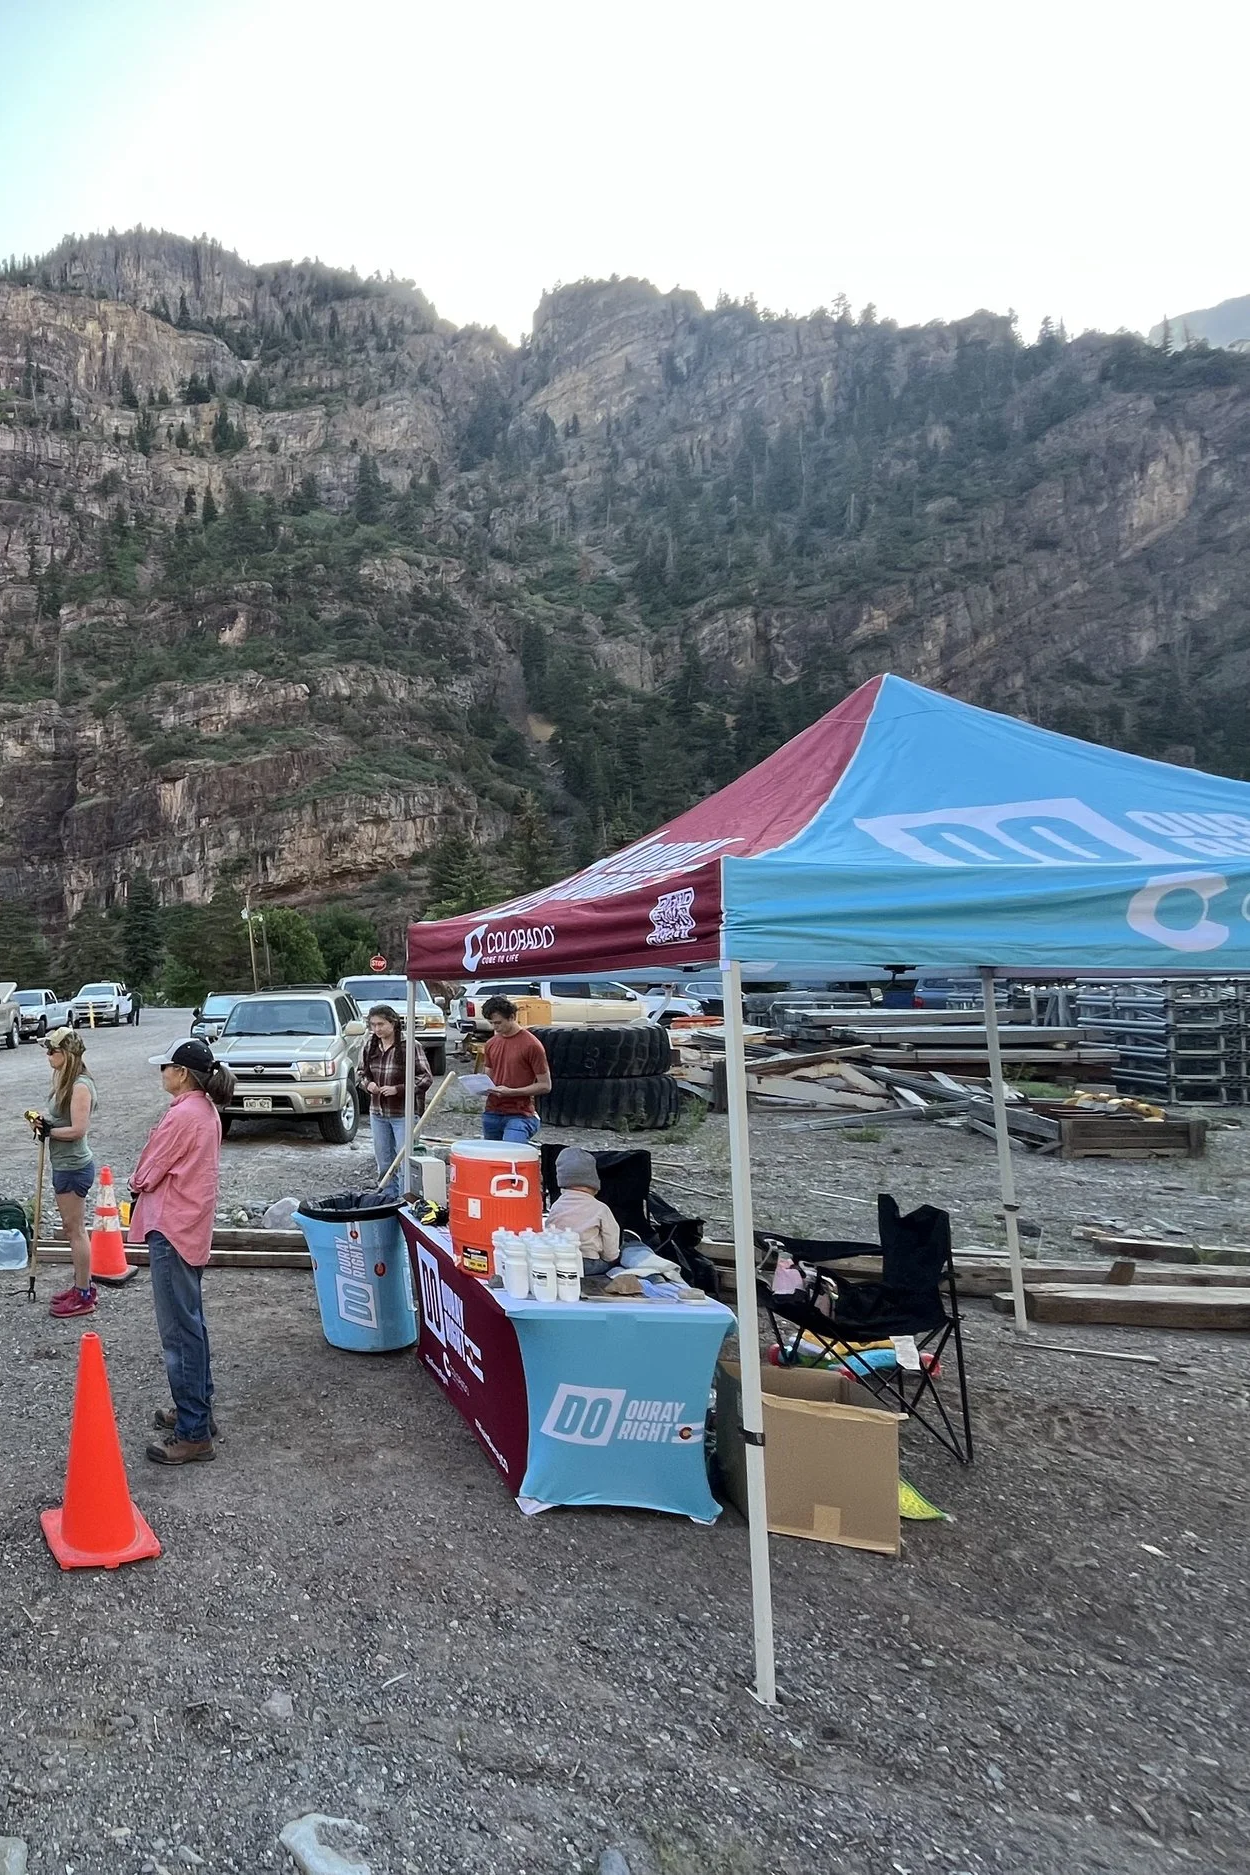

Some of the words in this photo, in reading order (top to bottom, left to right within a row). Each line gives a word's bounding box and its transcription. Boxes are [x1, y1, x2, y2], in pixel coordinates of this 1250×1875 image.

[486, 925, 555, 954] COLORADO
[371, 959, 386, 967] STOP
[505, 953, 520, 964] LIFE
[334, 1236, 352, 1276] OURAY
[349, 1240, 367, 1280] RIGHT
[342, 1282, 373, 1322] DO
[552, 1394, 613, 1440] DO
[624, 1399, 686, 1424] OURAY
[616, 1420, 674, 1444] RIGHT
